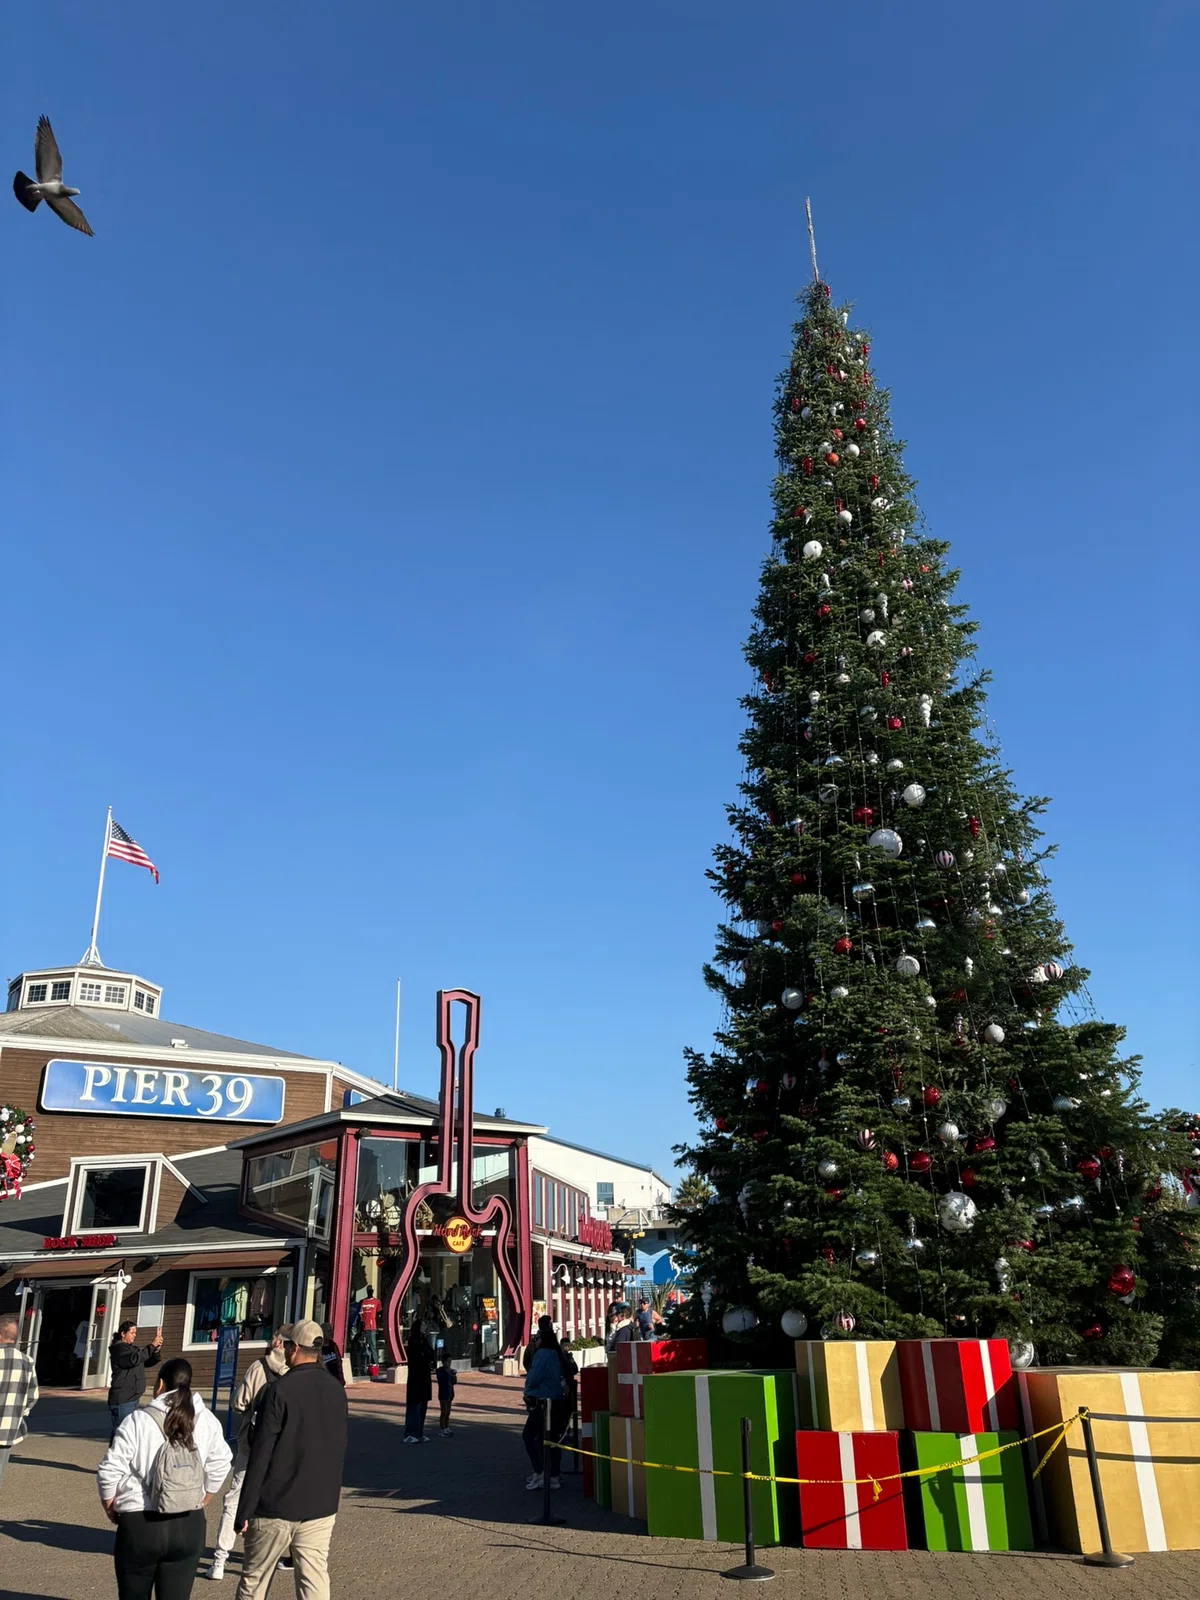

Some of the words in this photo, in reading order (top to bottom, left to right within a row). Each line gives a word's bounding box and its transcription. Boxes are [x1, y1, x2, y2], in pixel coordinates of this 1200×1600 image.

[79, 1065, 192, 1107] PIER
[196, 1074, 254, 1117] 39
[433, 1223, 460, 1238] Hard
[458, 1223, 484, 1240] Rock
[43, 1237, 79, 1250] ROCK
[80, 1234, 116, 1248] SHOP
